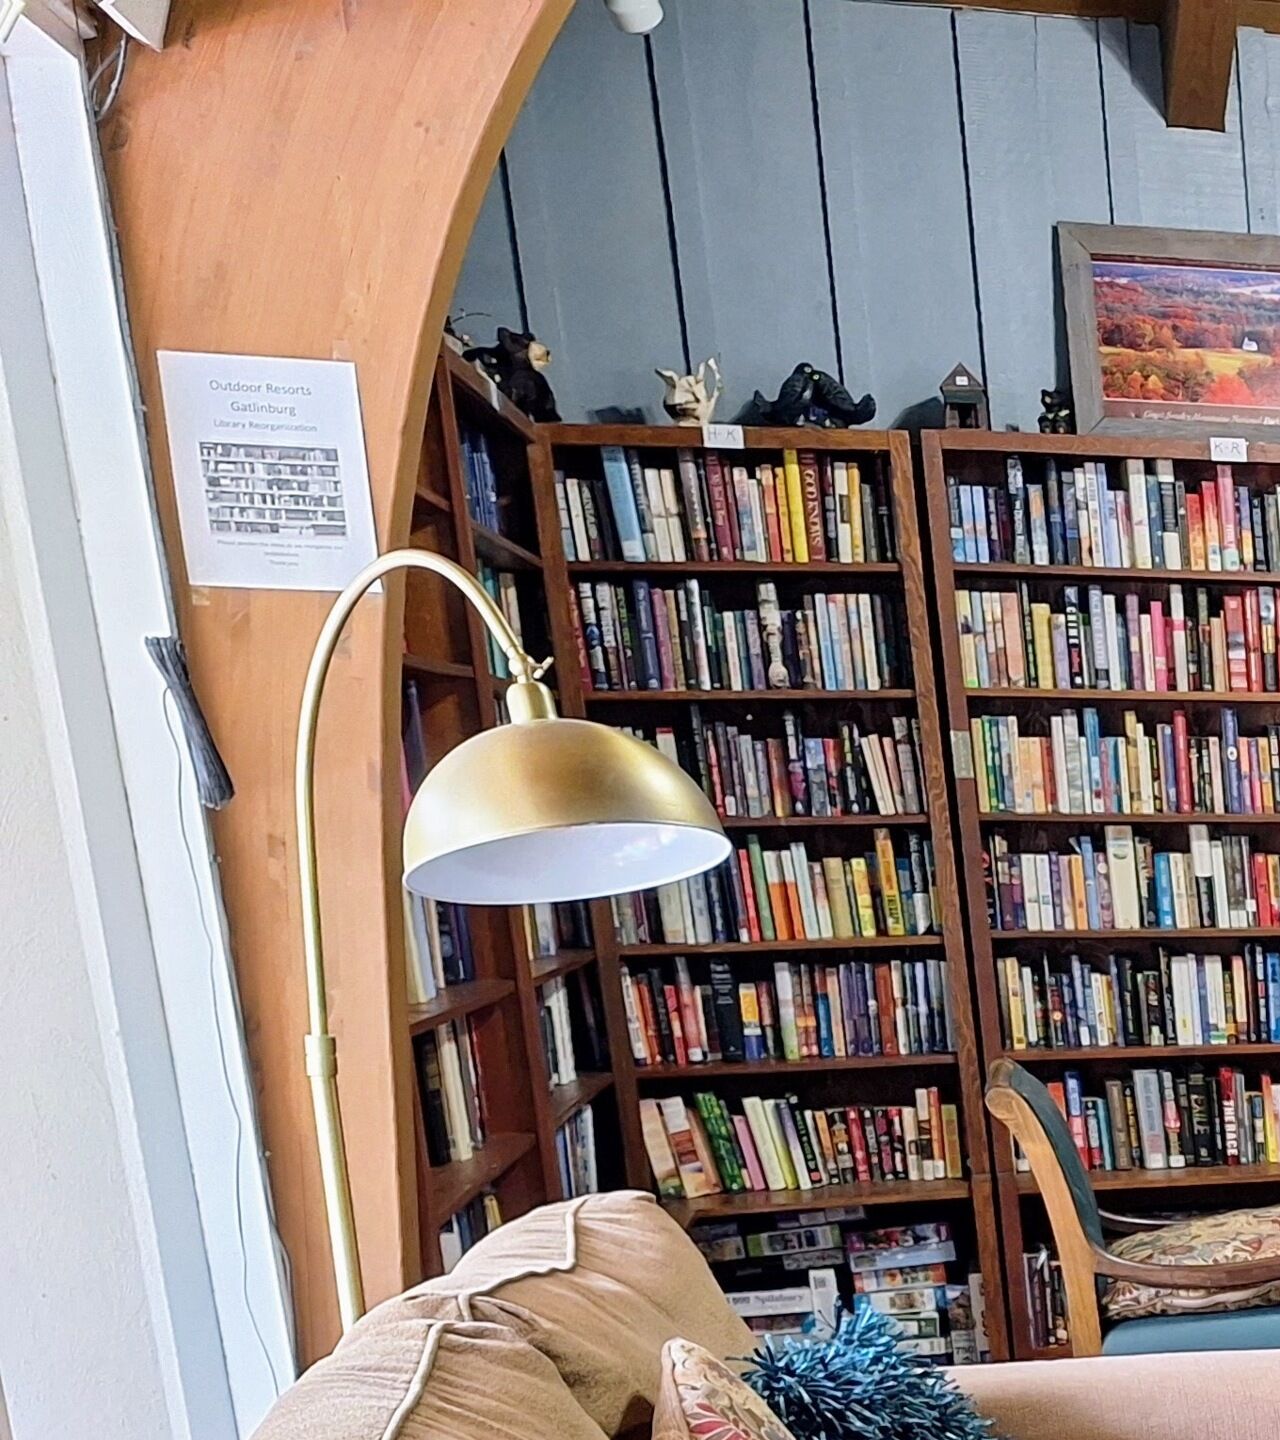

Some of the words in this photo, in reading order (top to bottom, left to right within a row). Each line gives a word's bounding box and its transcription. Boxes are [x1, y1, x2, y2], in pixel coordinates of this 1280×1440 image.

[209, 379, 262, 394] Outdoor
[266, 383, 312, 396] Resorts
[230, 401, 297, 417] Gatlinburg
[803, 470, 818, 498] GOD
[807, 501, 822, 548] KNOWS
[1222, 1099, 1236, 1125] THE
[1225, 1126, 1239, 1156] RACE
